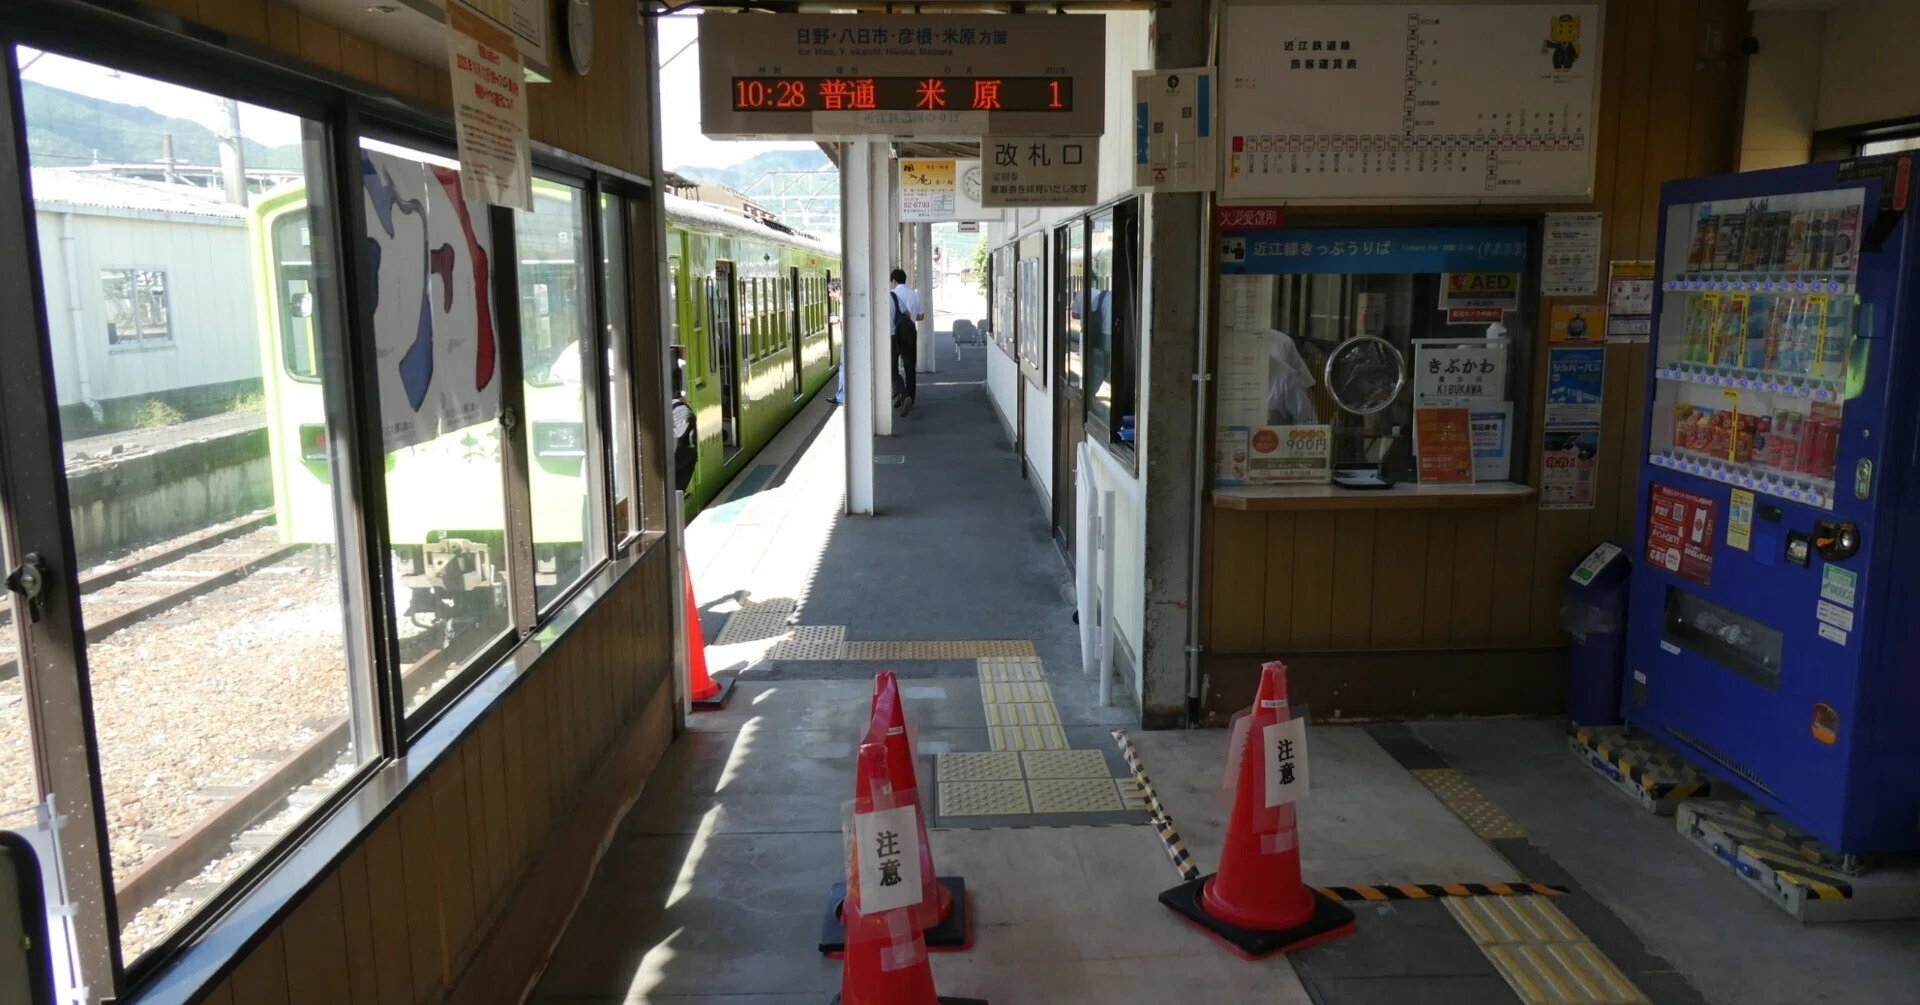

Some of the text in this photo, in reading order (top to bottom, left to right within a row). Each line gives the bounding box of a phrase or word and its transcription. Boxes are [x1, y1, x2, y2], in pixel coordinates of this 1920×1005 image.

[1284, 40, 1351, 52] 近江鉄道線
[1290, 59, 1358, 70] 旅客運賃表
[735, 78, 1062, 110] 10:28 普通 米原 1
[995, 143, 1083, 168] 改札口
[1219, 209, 1278, 226] 火災受信所
[1252, 239, 1392, 257] 近江線きっぷうりば
[1471, 275, 1511, 289] AED
[1428, 357, 1495, 374] きぶかわ
[1437, 384, 1483, 395] KIBUKAWA
[1286, 438, 1327, 452] 900円
[1277, 738, 1297, 786] 注意
[875, 829, 903, 888] 注意
